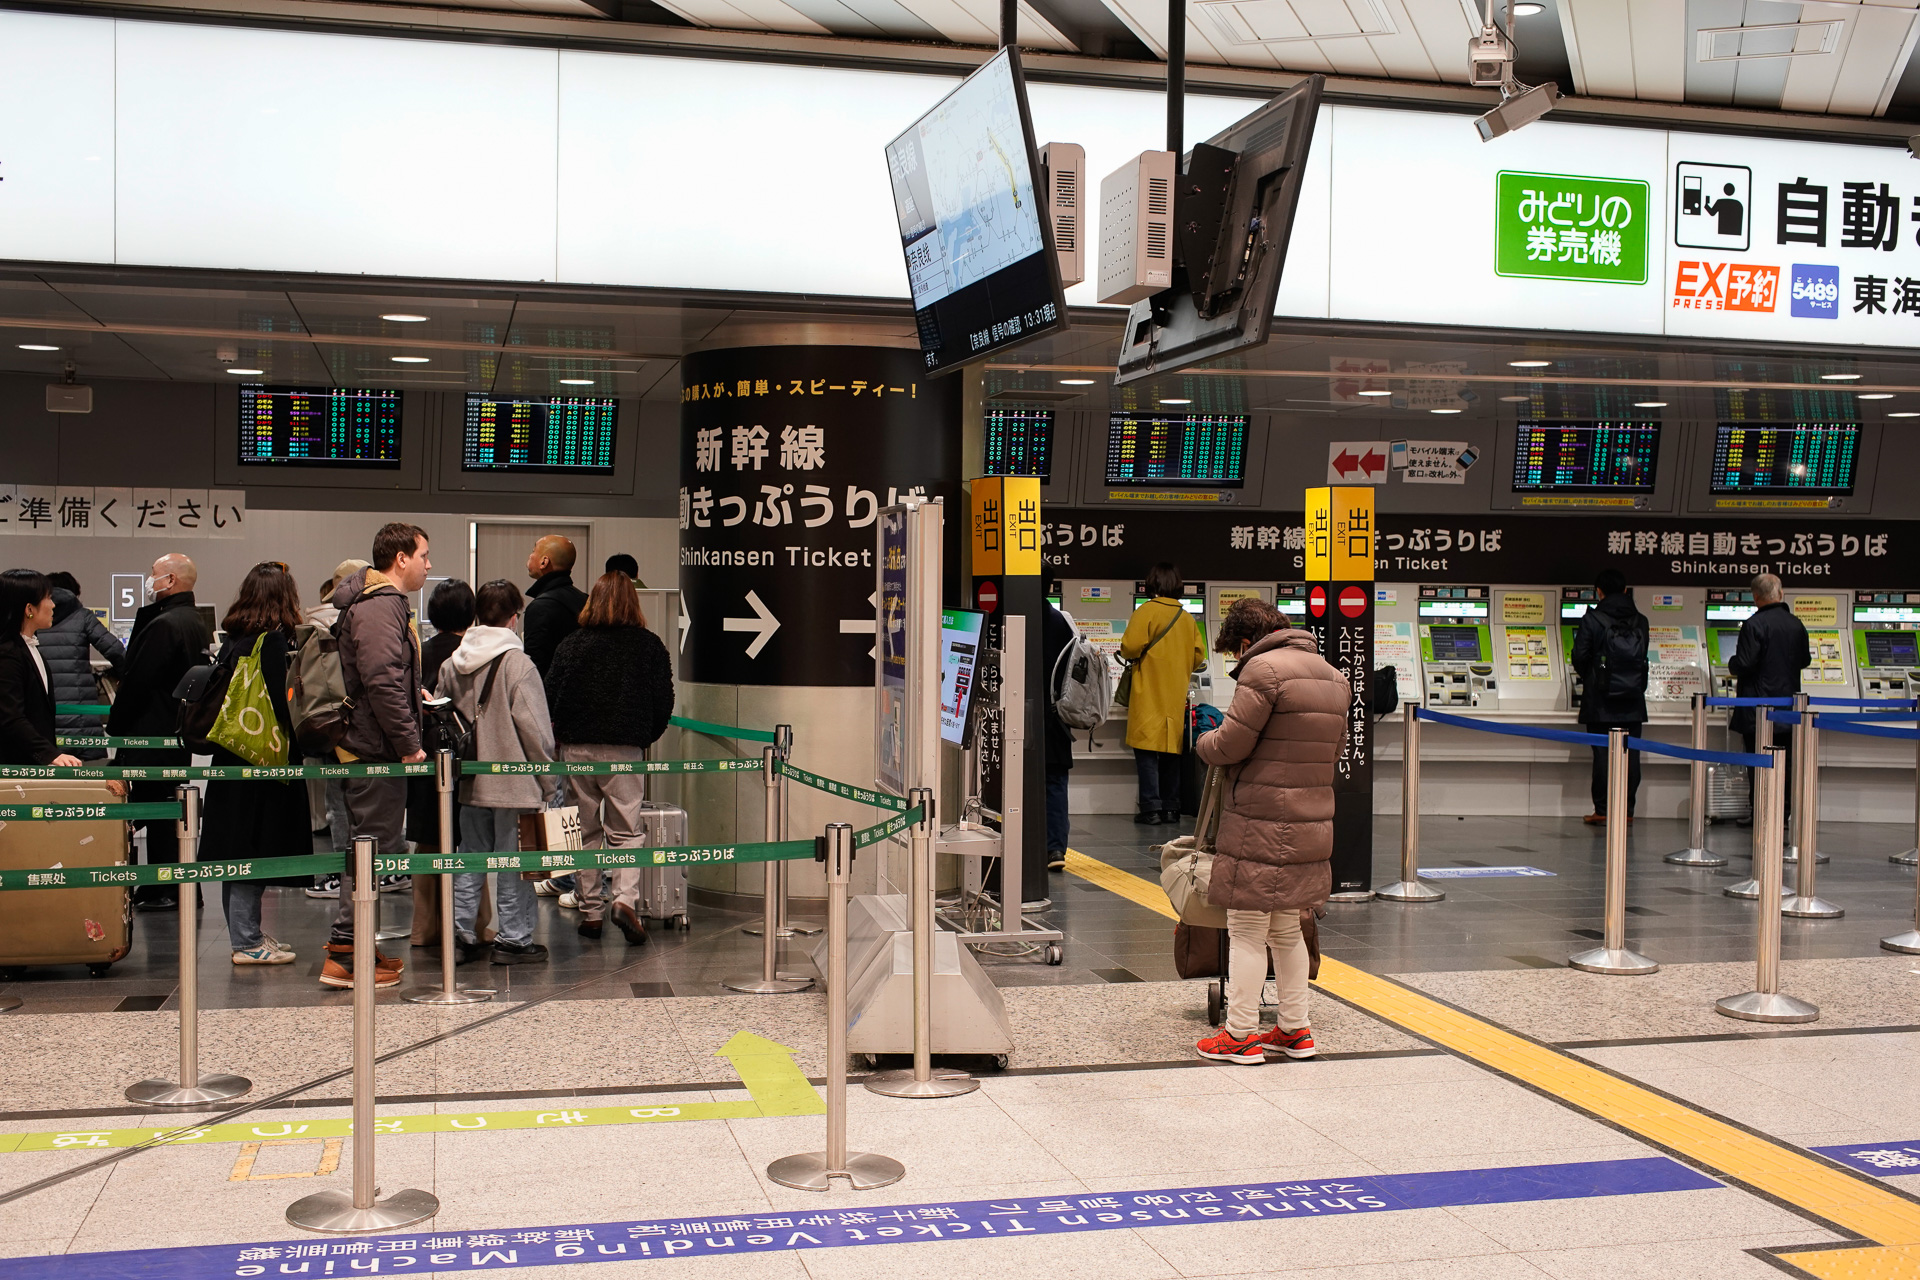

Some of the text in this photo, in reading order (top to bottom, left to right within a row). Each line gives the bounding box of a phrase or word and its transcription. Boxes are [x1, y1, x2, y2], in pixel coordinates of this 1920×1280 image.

[1518, 189, 1632, 228] みどりの
[1777, 176, 1920, 252] 自動
[1526, 226, 1622, 266] 券売機
[1673, 297, 1723, 311] PRESS
[1792, 282, 1838, 302] 5489
[696, 424, 826, 472] 新幹線
[1409, 459, 1452, 468] 使えません。
[984, 499, 998, 552] 出口
[1008, 513, 1017, 539] EXIT
[1018, 498, 1036, 552] 出口
[1316, 508, 1328, 558] 出口
[1337, 522, 1346, 546] EXIT
[1348, 508, 1368, 558] 出口
[1608, 531, 1888, 556] 新幹線自動きっぷうりば
[681, 547, 775, 567] Shinkansen
[785, 547, 872, 567] Ticket
[1396, 557, 1448, 570] Ticket
[1671, 560, 1831, 575] Shinkansen Ticket
[121, 588, 135, 608] 5
[1353, 626, 1366, 767] ここからは入れません。
[1, 768, 56, 778] きっぷうりば
[73, 768, 104, 778] Tickets
[122, 769, 147, 778] 售票处
[162, 770, 187, 778] 售票處
[202, 769, 226, 778] 매표소
[253, 768, 304, 777] きっぷうりば
[320, 767, 350, 776] Tickets
[366, 766, 390, 775] 售票处
[502, 763, 550, 773] きっぷうりば
[566, 764, 594, 772] Tickets
[610, 764, 633, 772] 售票处
[646, 762, 670, 772] 售票處
[44, 807, 106, 818] きっぷうりば
[432, 858, 466, 870] 매표소
[486, 856, 520, 869] 售票處
[541, 854, 575, 868] 售票处
[594, 852, 636, 864] Tickets
[666, 848, 735, 863] きっぷうりば
[27, 862, 252, 886] 售票处 Tickets きっぷうりば
[989, 1181, 1357, 1218] 신칸센 전용 발매기
[236, 1193, 1388, 1277] Shinkansen Ticket Vending Machine
[626, 1206, 959, 1241] 新干线专用售票机
